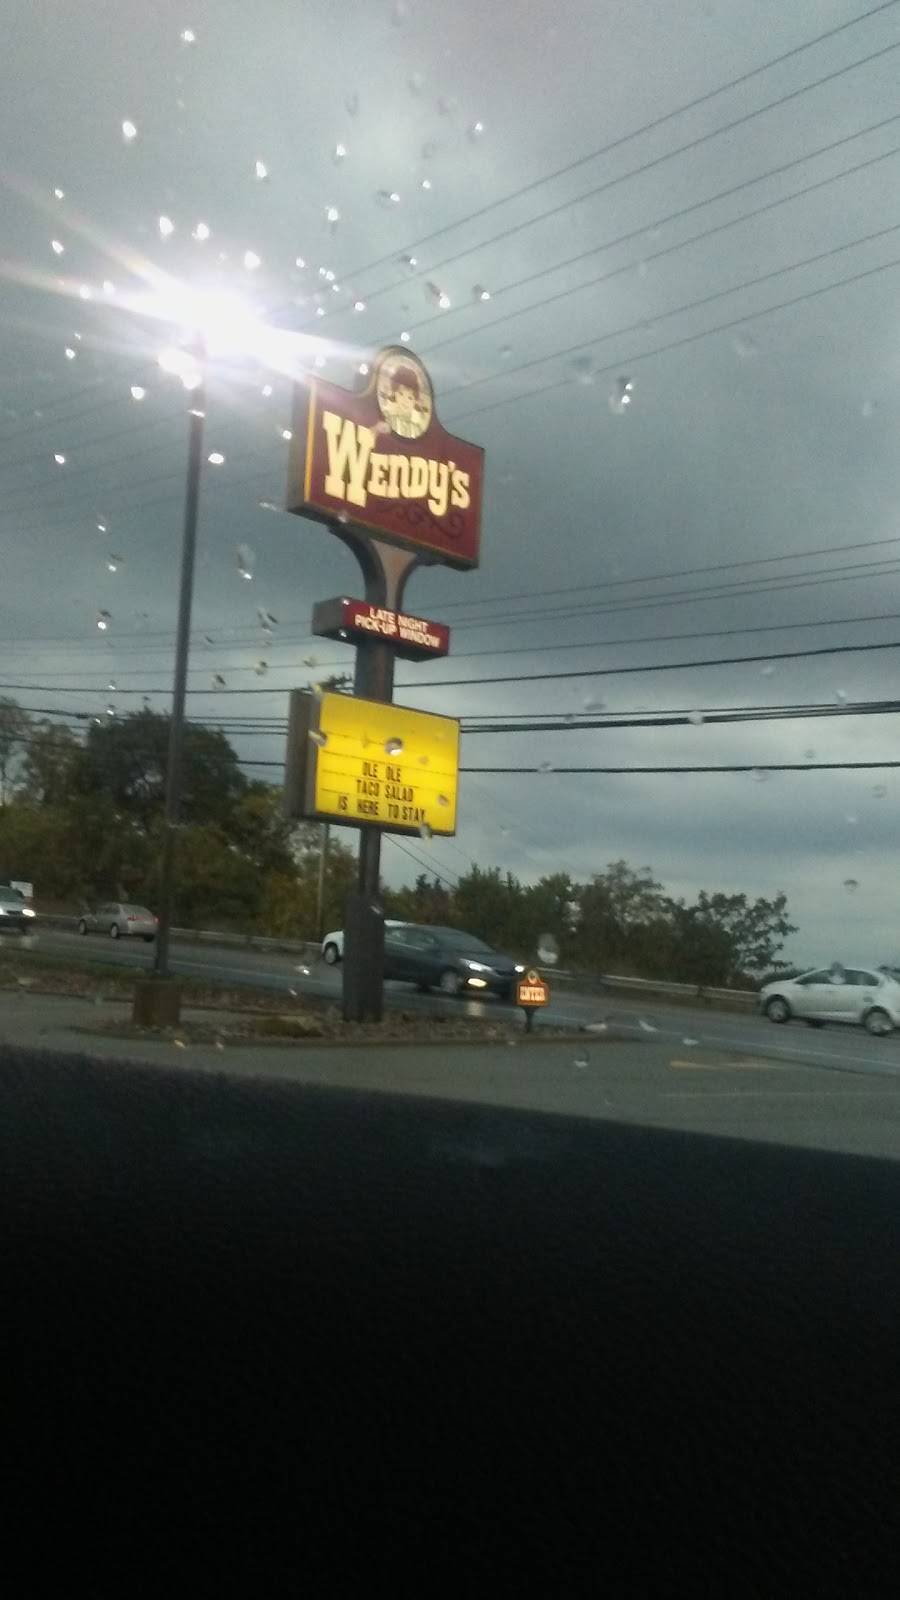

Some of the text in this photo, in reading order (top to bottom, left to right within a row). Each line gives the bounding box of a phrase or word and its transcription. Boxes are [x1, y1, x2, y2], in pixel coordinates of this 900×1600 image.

[354, 614, 440, 648] PICK-UP WINDOW
[369, 606, 429, 632] LATE NIGHT
[363, 761, 401, 783] OLE OLE
[357, 779, 414, 802] TACO SALAD
[338, 795, 425, 822] IS HERE TO STAY
